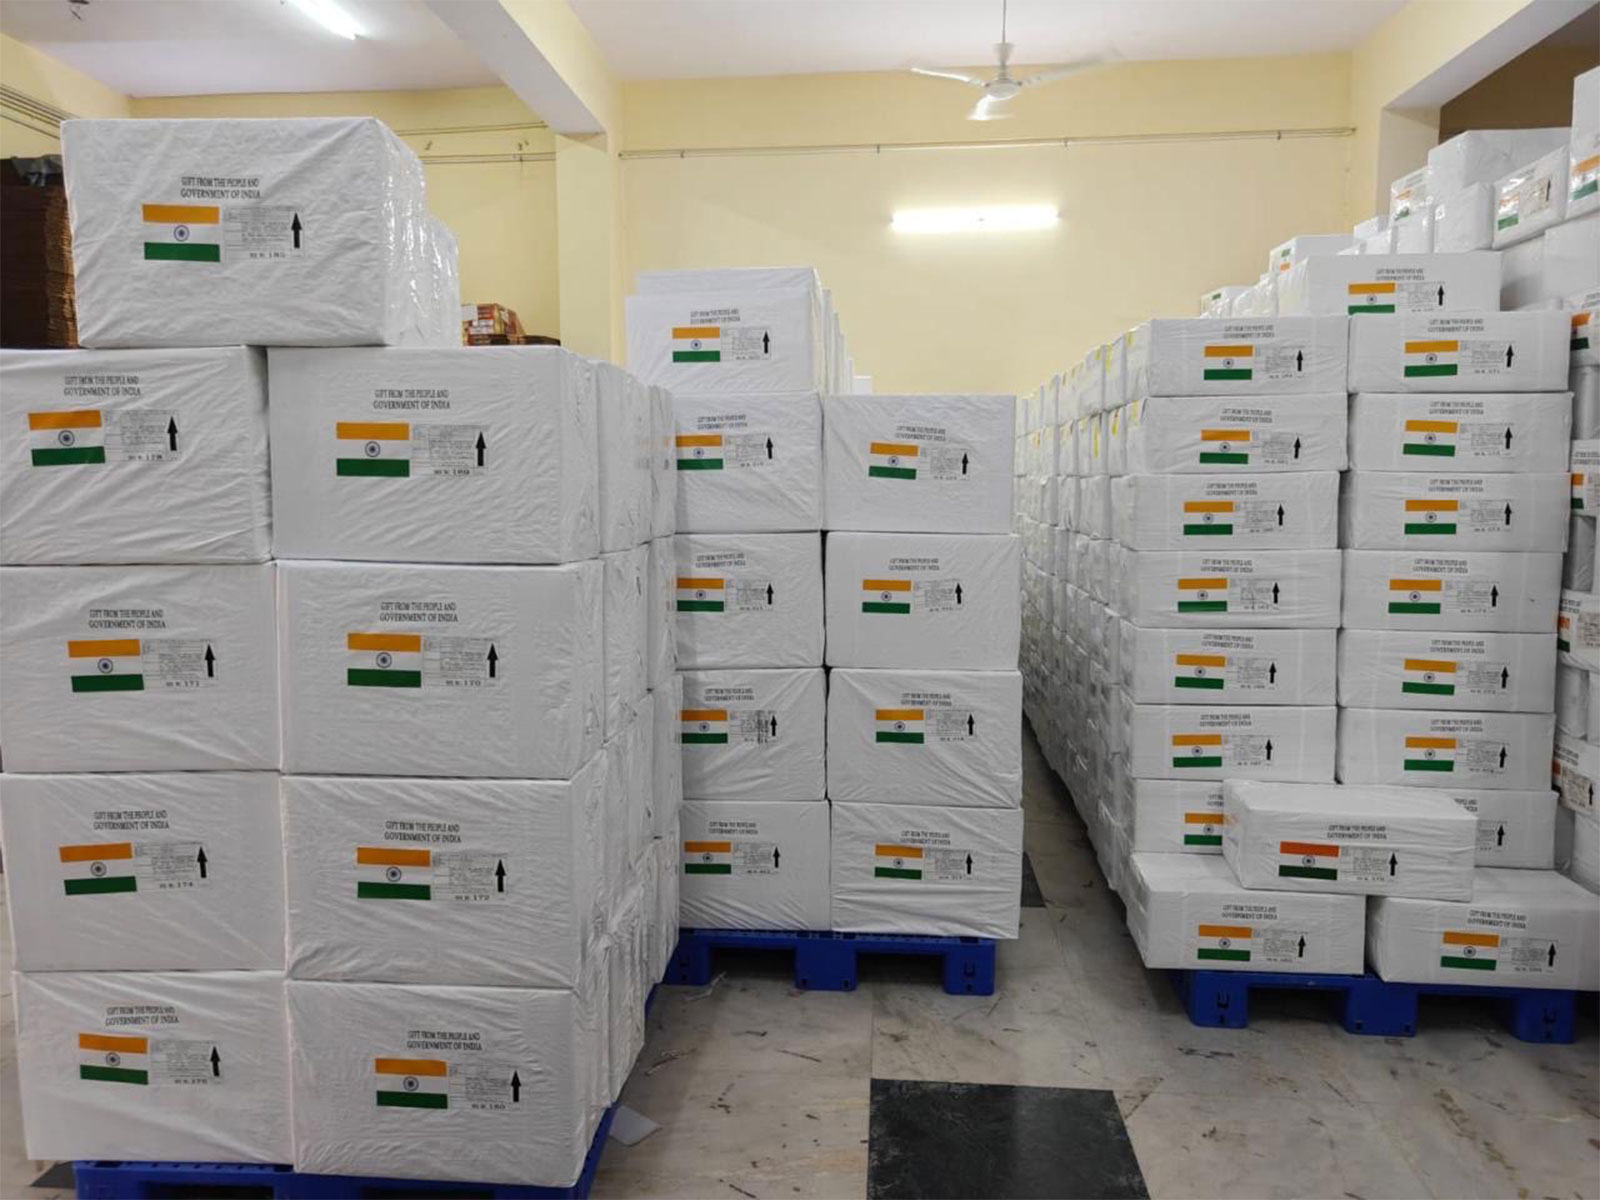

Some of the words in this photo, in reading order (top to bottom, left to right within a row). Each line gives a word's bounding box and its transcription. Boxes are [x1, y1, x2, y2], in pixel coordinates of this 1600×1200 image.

[181, 188, 228, 198] GOVERNMENT
[64, 387, 110, 396] GOVERNMENT
[373, 400, 419, 409] GOVERNMENT
[380, 613, 426, 622] GOVERNMENT
[89, 620, 135, 628] GOVERNMENT
[93, 821, 139, 830] GOVERNMENT
[384, 832, 430, 842] GOVERNMENT
[106, 1016, 149, 1026] GOVERNMENT
[407, 1041, 452, 1050] GOVERNMENT
